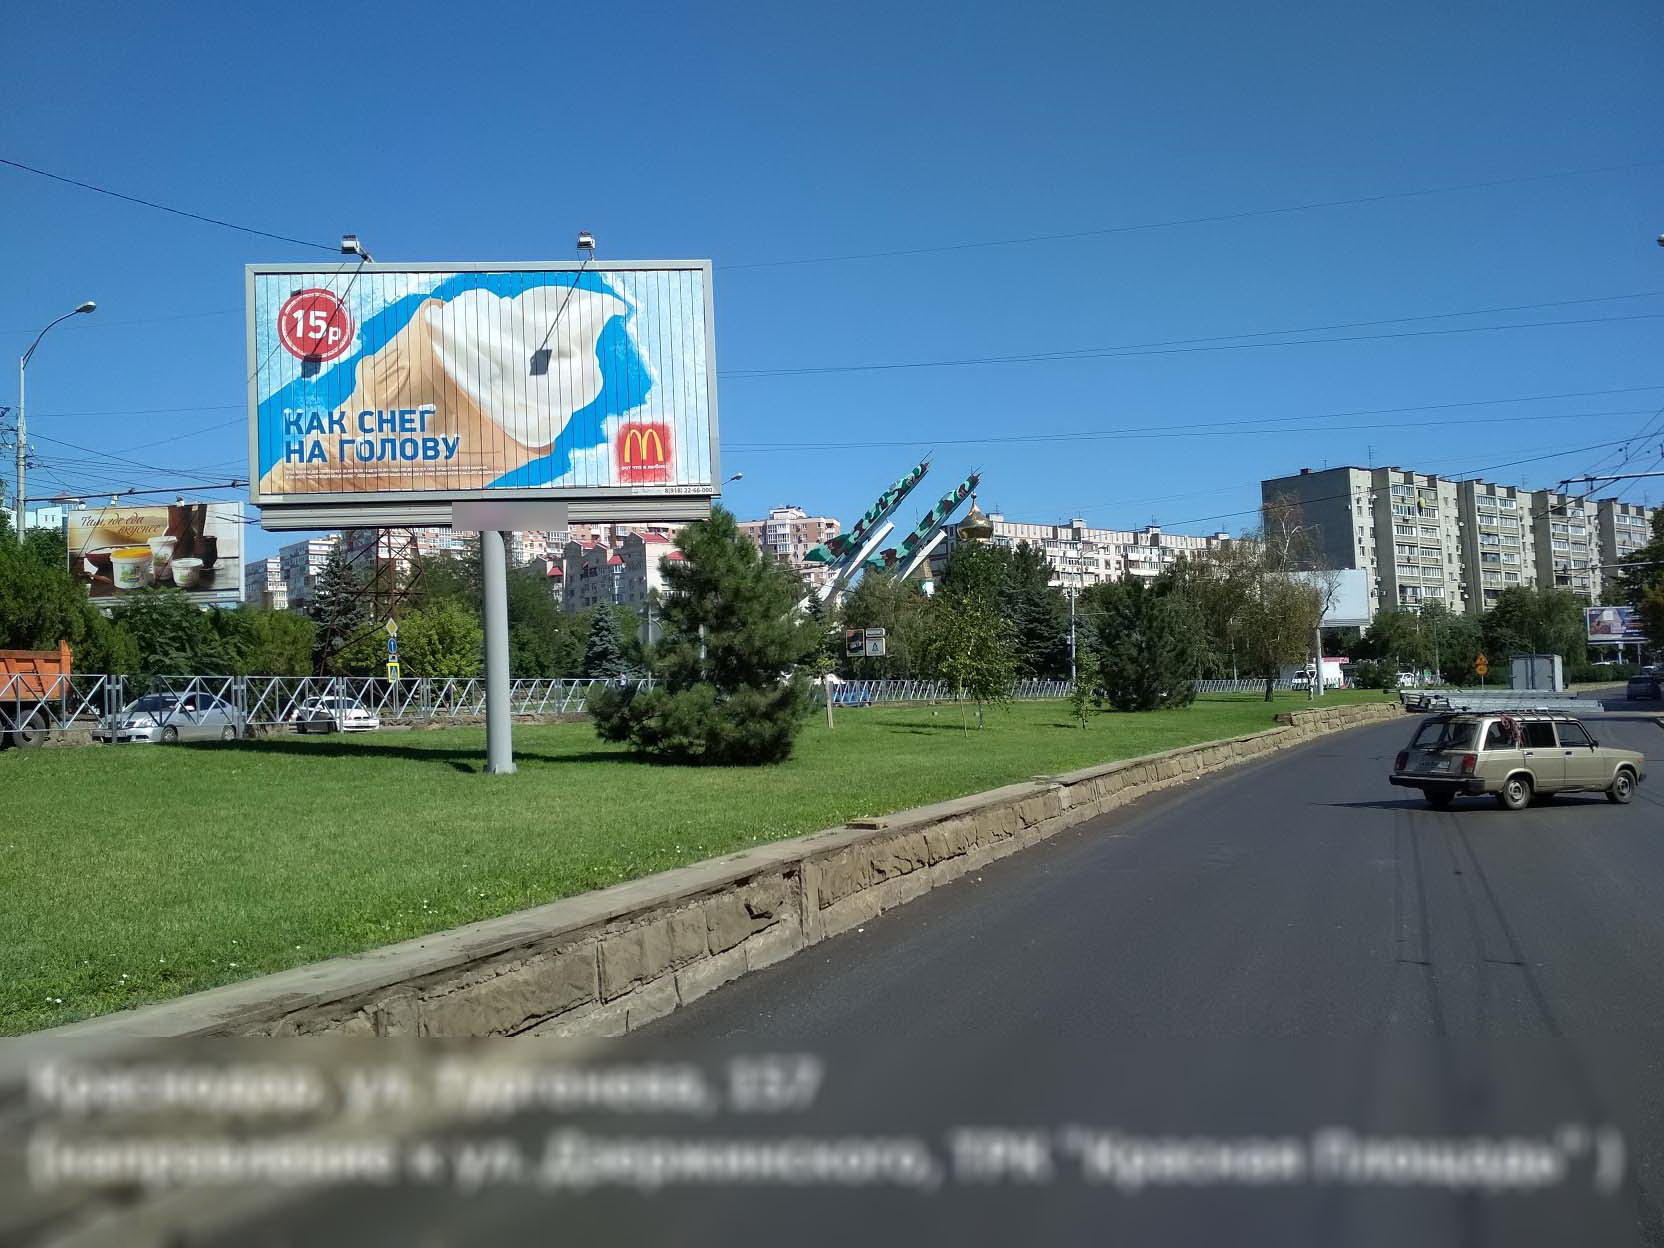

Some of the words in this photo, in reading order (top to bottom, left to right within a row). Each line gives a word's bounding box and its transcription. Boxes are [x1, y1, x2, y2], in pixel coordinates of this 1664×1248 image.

[284, 410, 347, 435] КАК
[358, 406, 436, 434] СНЕГ
[285, 439, 328, 463] НА
[339, 436, 460, 462] ГОЛОВУ
